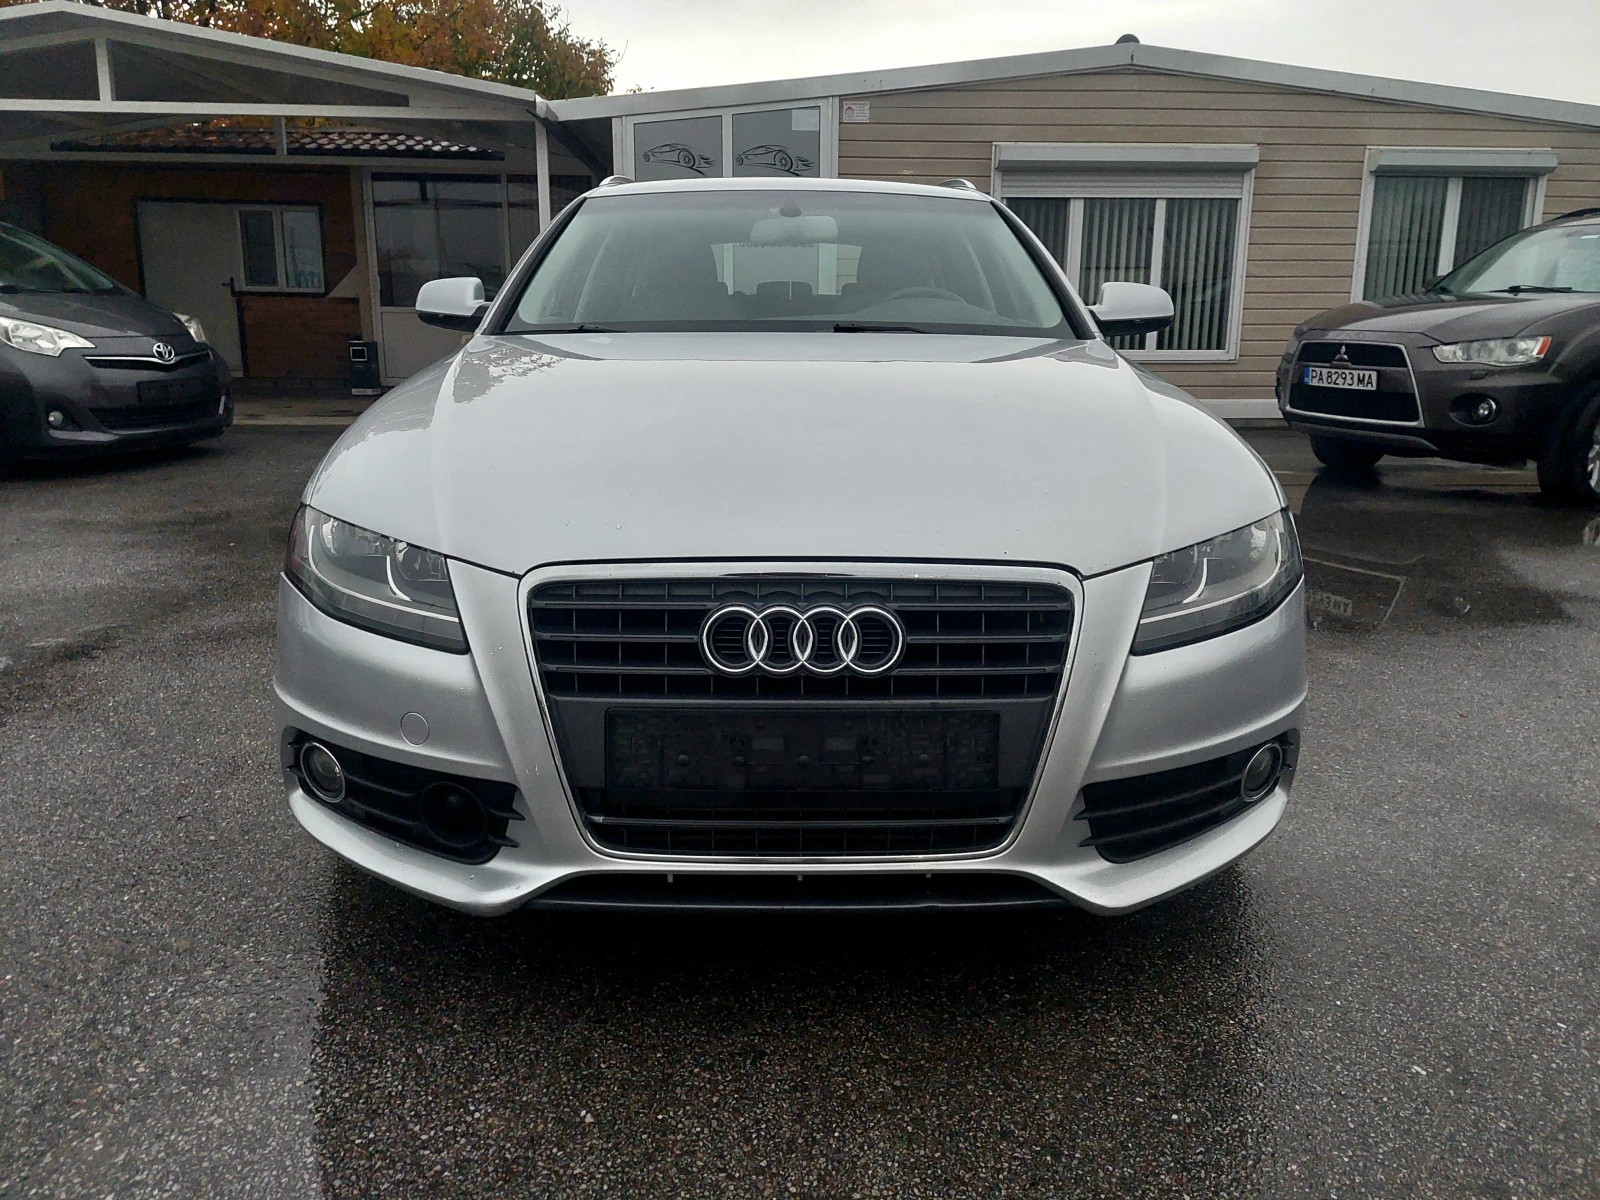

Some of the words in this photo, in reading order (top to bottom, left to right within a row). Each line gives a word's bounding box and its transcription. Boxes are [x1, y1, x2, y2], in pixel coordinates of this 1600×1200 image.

[1311, 369, 1324, 384] PA
[1326, 371, 1354, 386] 8293
[1357, 372, 1373, 387] MA
